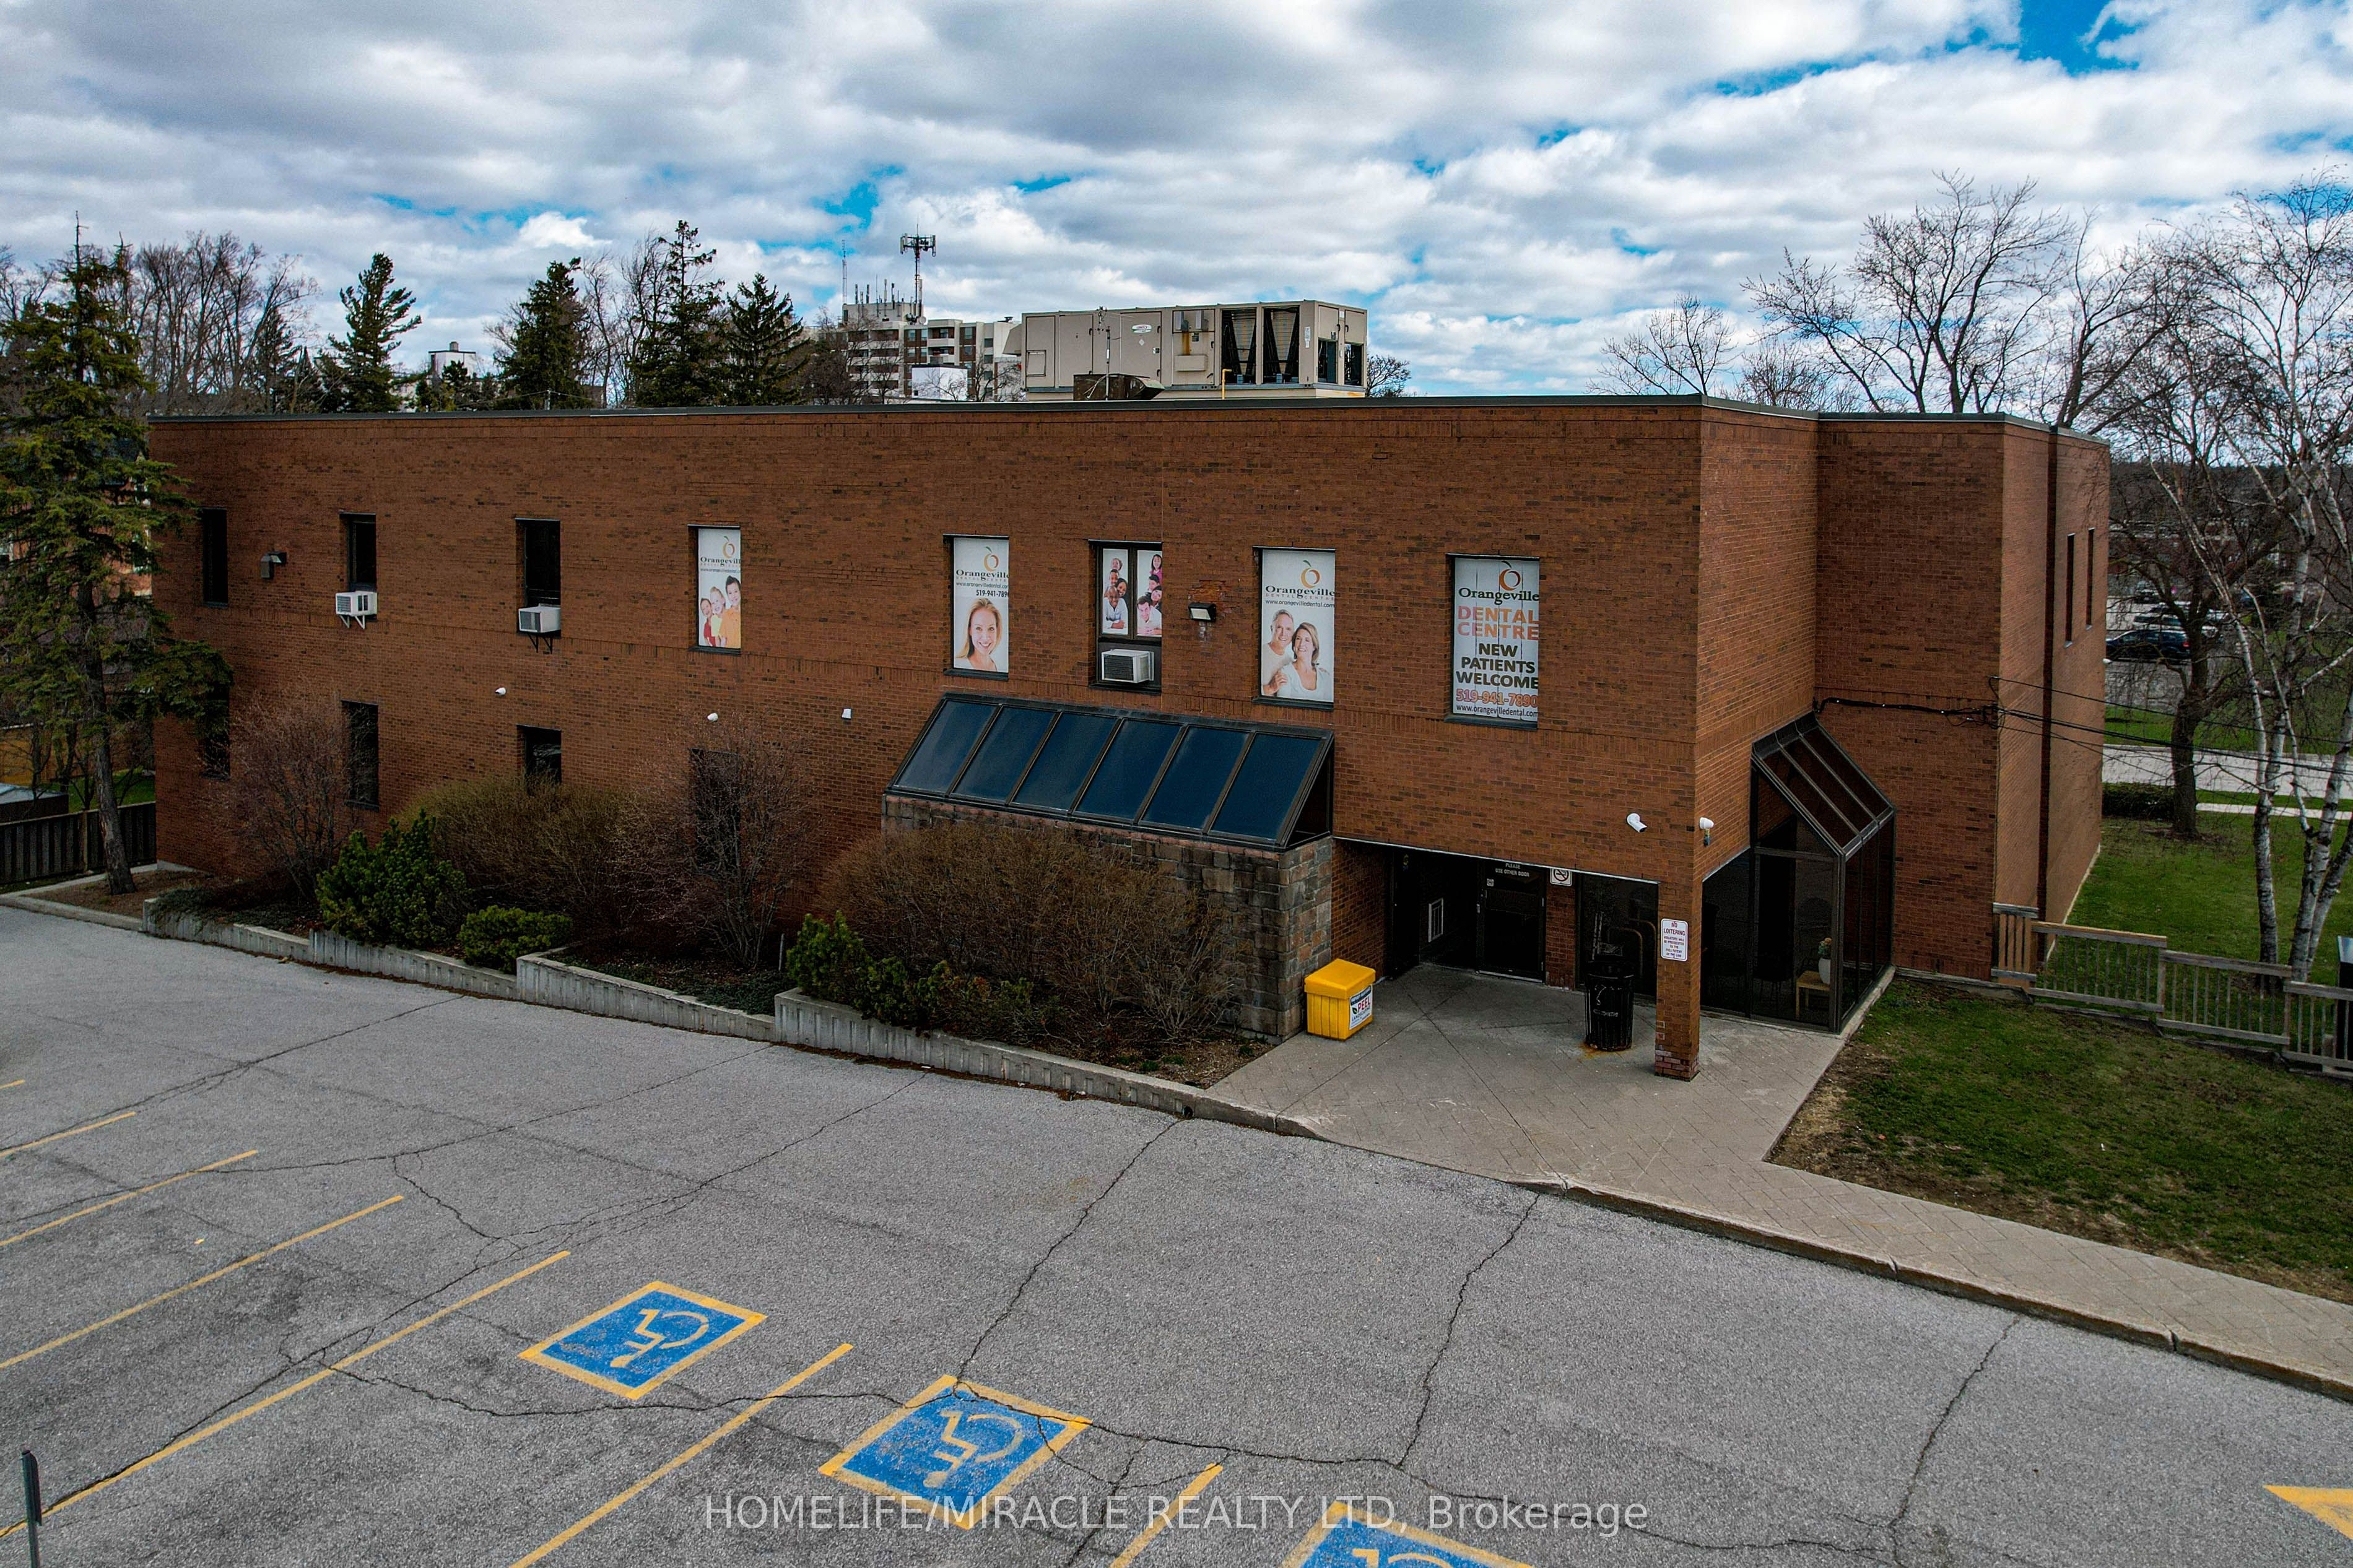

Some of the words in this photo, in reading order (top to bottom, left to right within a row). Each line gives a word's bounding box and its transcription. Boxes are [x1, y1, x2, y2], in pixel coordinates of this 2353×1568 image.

[1266, 586, 1335, 599] Orangeville
[1458, 587, 1539, 605] Orangeville
[1458, 606, 1540, 625] DENTAL
[1457, 622, 1539, 641] CENTRE
[1479, 643, 1518, 657] NEW
[1461, 657, 1535, 674] PATIENTS
[1456, 671, 1538, 689] WELCOME
[1456, 688, 1538, 708] 519-941-7890
[1456, 704, 1538, 717] www.orangevilledental.com
[1663, 928, 1685, 936] LOITERING
[1358, 996, 1370, 1013] PEEL
